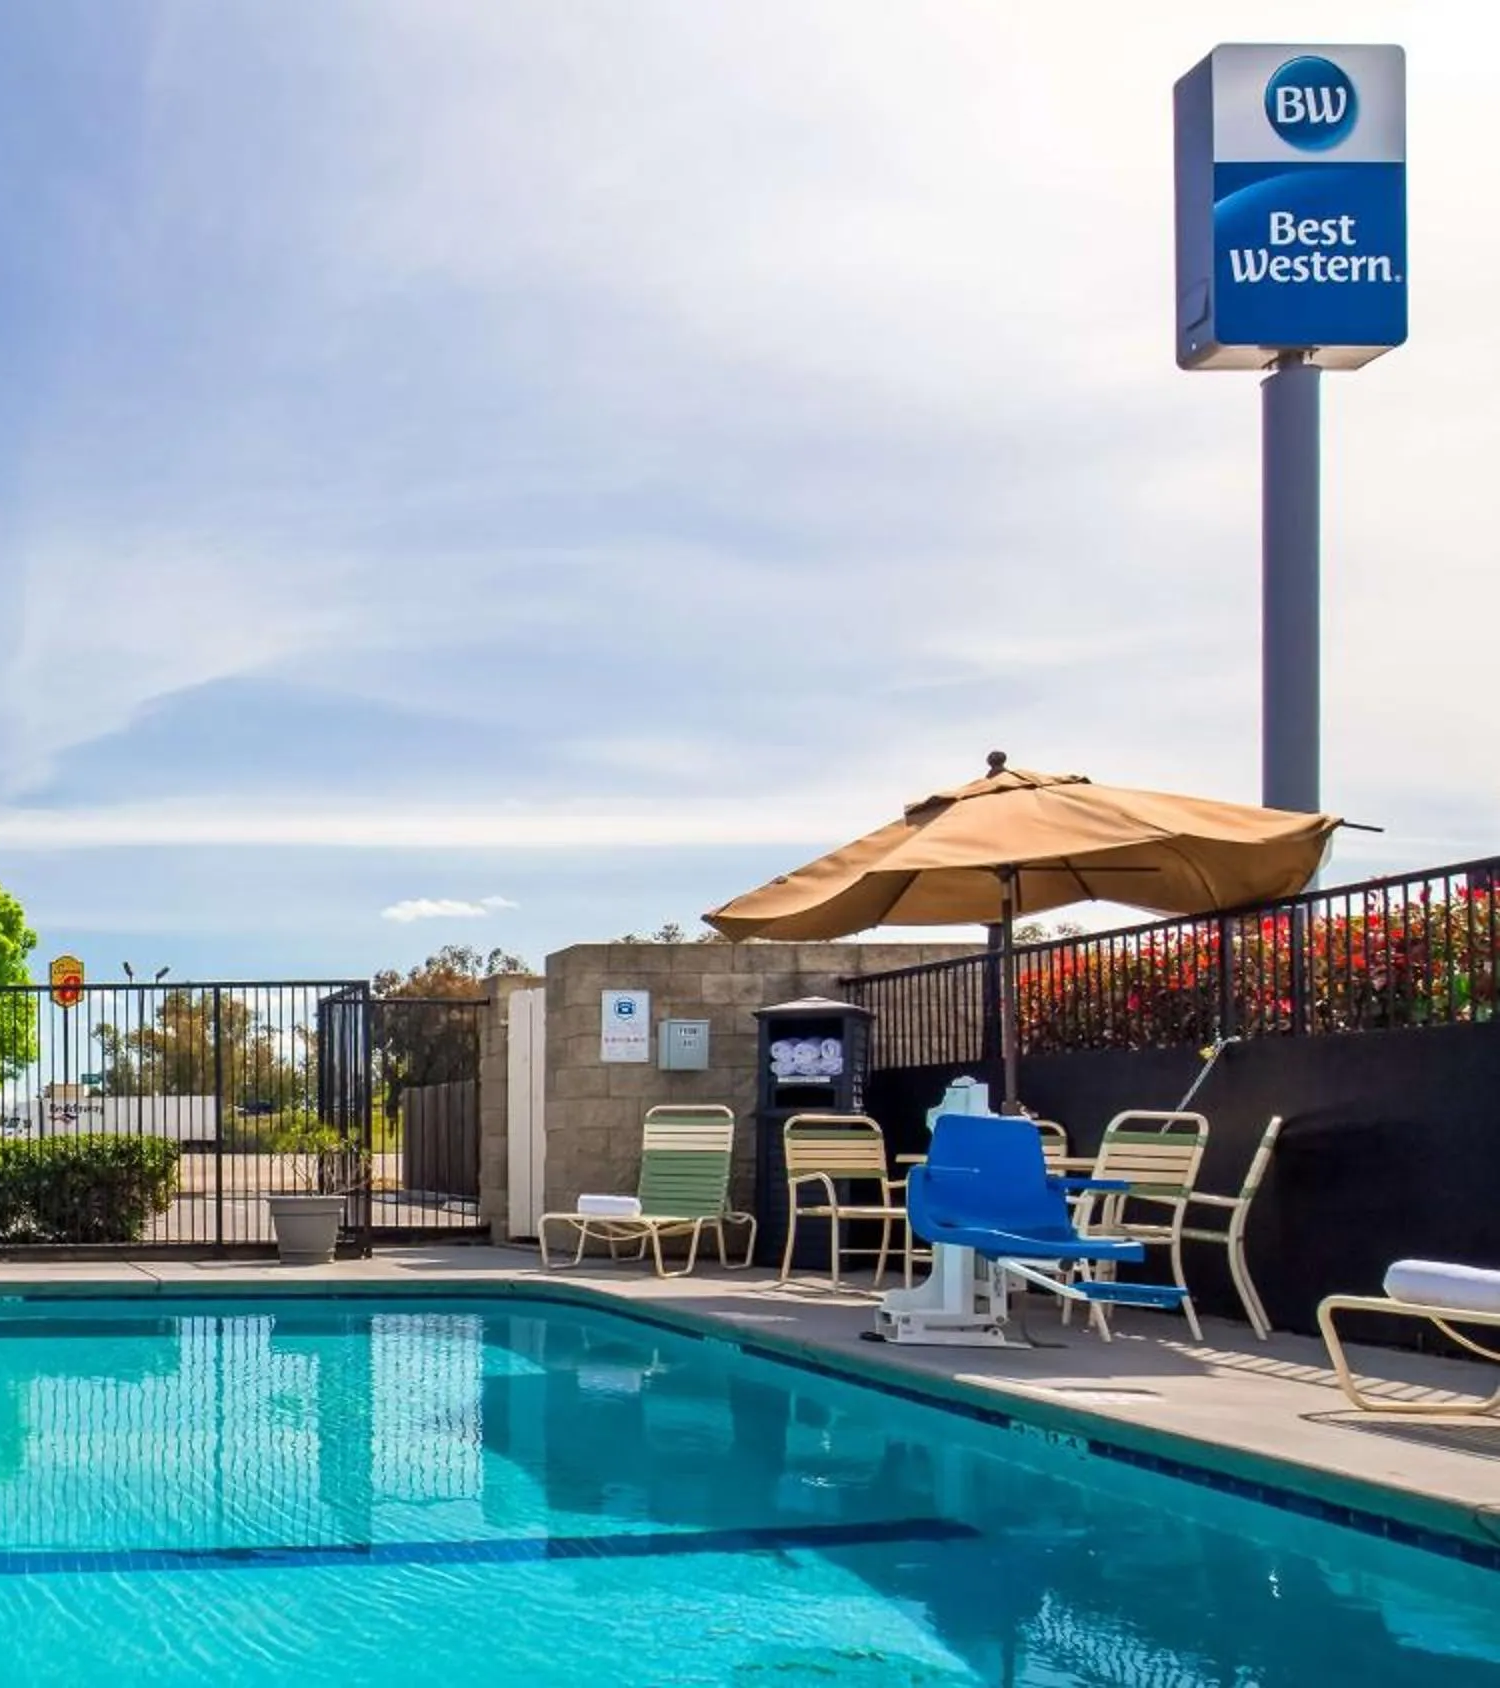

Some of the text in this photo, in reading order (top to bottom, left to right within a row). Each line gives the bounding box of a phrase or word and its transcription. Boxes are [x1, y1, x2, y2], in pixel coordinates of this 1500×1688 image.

[1276, 86, 1347, 124] BW
[1269, 211, 1357, 246] Best
[1229, 248, 1393, 283] Western
